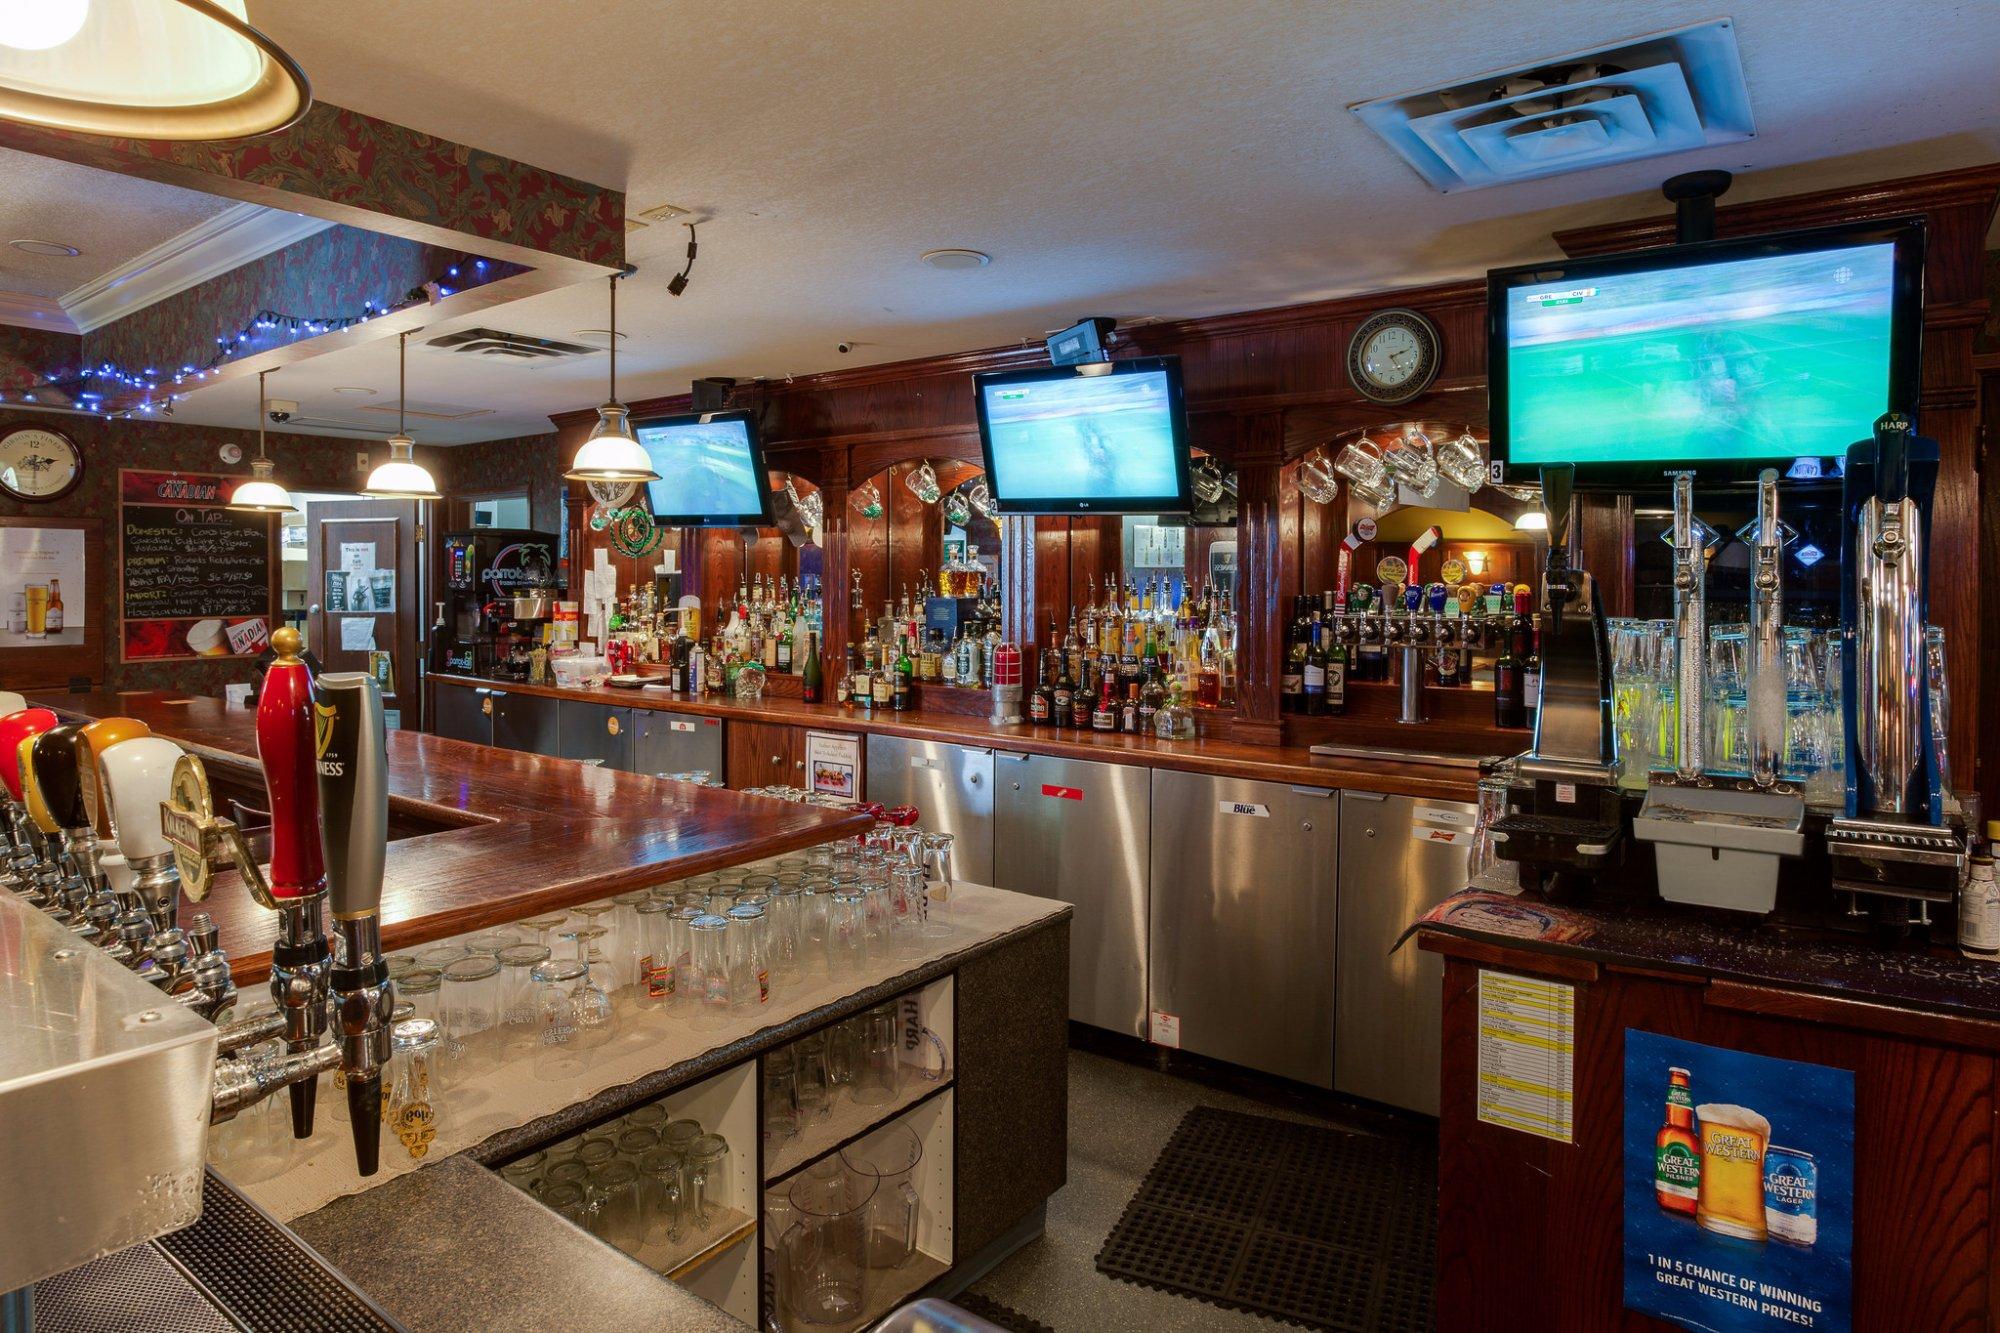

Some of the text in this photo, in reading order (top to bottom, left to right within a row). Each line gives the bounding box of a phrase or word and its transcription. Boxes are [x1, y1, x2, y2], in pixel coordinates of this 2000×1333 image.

[1880, 421, 1909, 431] HARP
[29, 440, 40, 449] 12
[1491, 464, 1502, 481] 3
[158, 483, 217, 500] CANADIAN
[990, 501, 997, 511] 2
[1232, 803, 1256, 815] Blue
[1710, 1130, 1754, 1149] GREAT
[1703, 1141, 1761, 1162] WESTERN
[1662, 1153, 1695, 1167] GREAT
[1656, 1160, 1700, 1177] WESTERN
[1665, 1172, 1694, 1182] PILSNER
[1769, 1173, 1808, 1187] GREAT
[1763, 1181, 1816, 1200] WESTERN
[1775, 1196, 1804, 1205] LAGER
[1648, 1253, 1823, 1314] 1 IN 5 CHANCE OF WINNING
[1656, 1270, 1815, 1328] GREAT WESTERN PRIZES!
